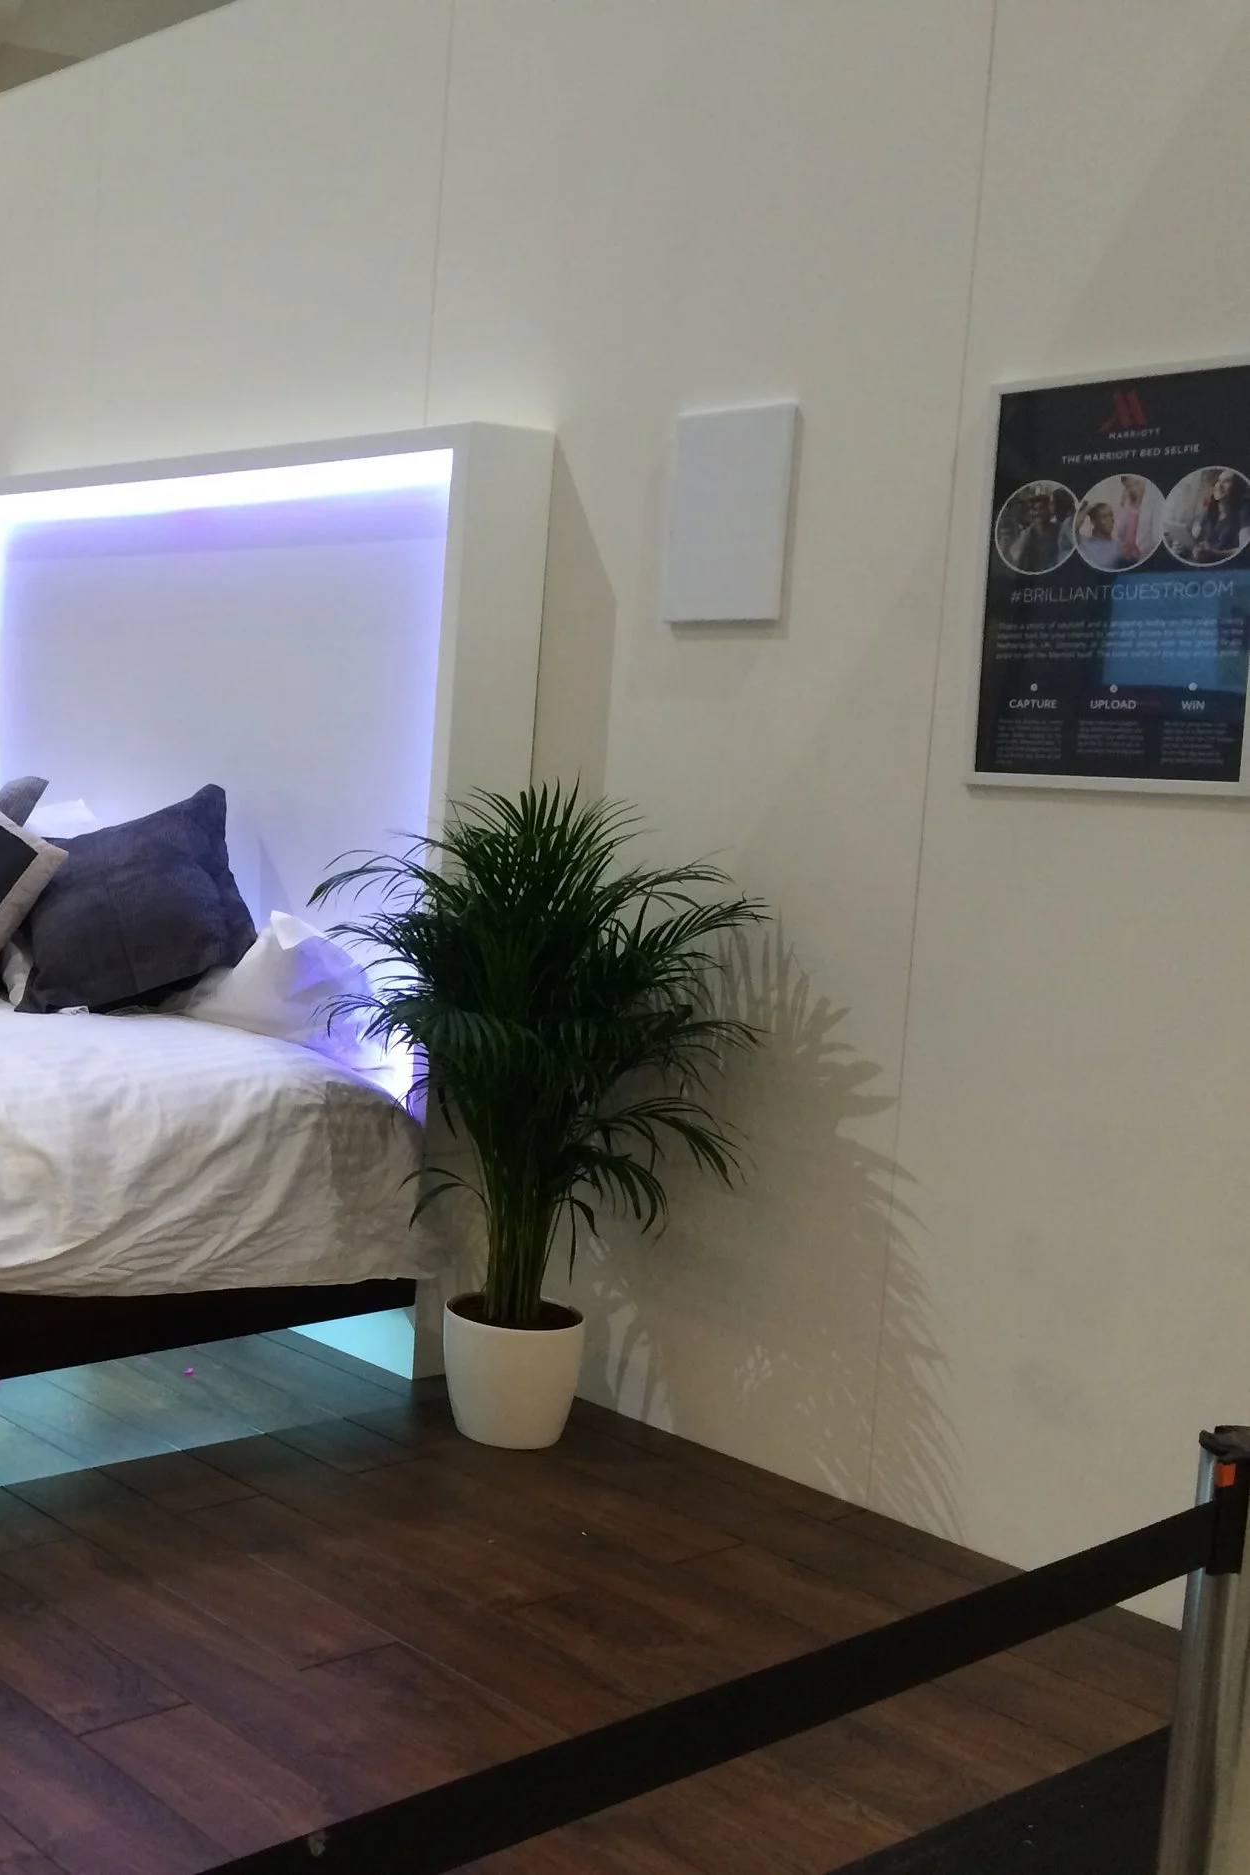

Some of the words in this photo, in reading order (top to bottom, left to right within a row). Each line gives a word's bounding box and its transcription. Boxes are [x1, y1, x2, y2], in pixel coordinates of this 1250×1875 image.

[1108, 427, 1162, 441] MARRIOTT
[1061, 454, 1082, 465] THE
[1084, 449, 1137, 462] MARRIOTT
[1139, 447, 1161, 458] BED
[1163, 443, 1201, 456] SELFIE
[1010, 580, 1234, 603] #BRILLIANTGUESTROOM
[1008, 698, 1058, 709] CAPTURE
[1089, 699, 1137, 711] UPLOAD
[1181, 699, 1206, 710] WIN
